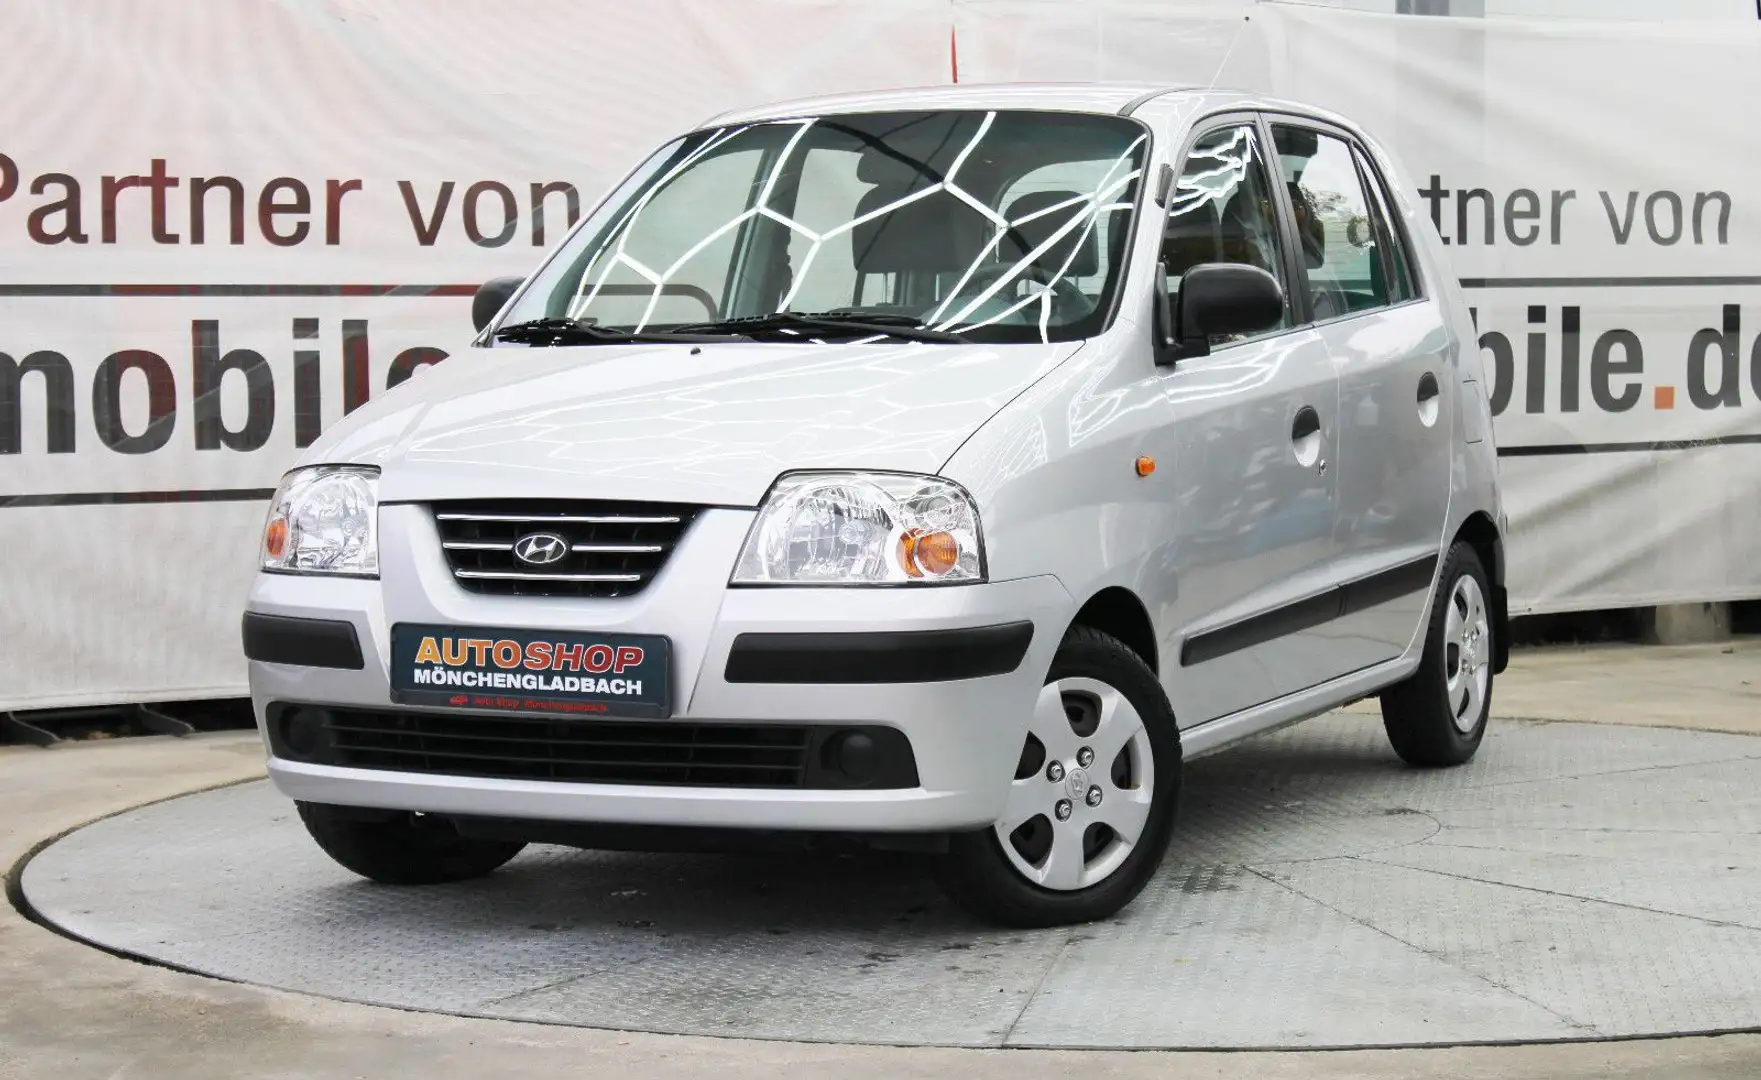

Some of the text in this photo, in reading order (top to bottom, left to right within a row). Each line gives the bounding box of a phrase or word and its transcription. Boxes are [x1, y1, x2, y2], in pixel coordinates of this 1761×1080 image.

[397, 179, 581, 248] von
[1416, 174, 1732, 247] tner von
[0, 317, 451, 455] mobil
[413, 667, 642, 695] MÖNCHENGLADBACH
[414, 636, 645, 674] AUTOSHOP
